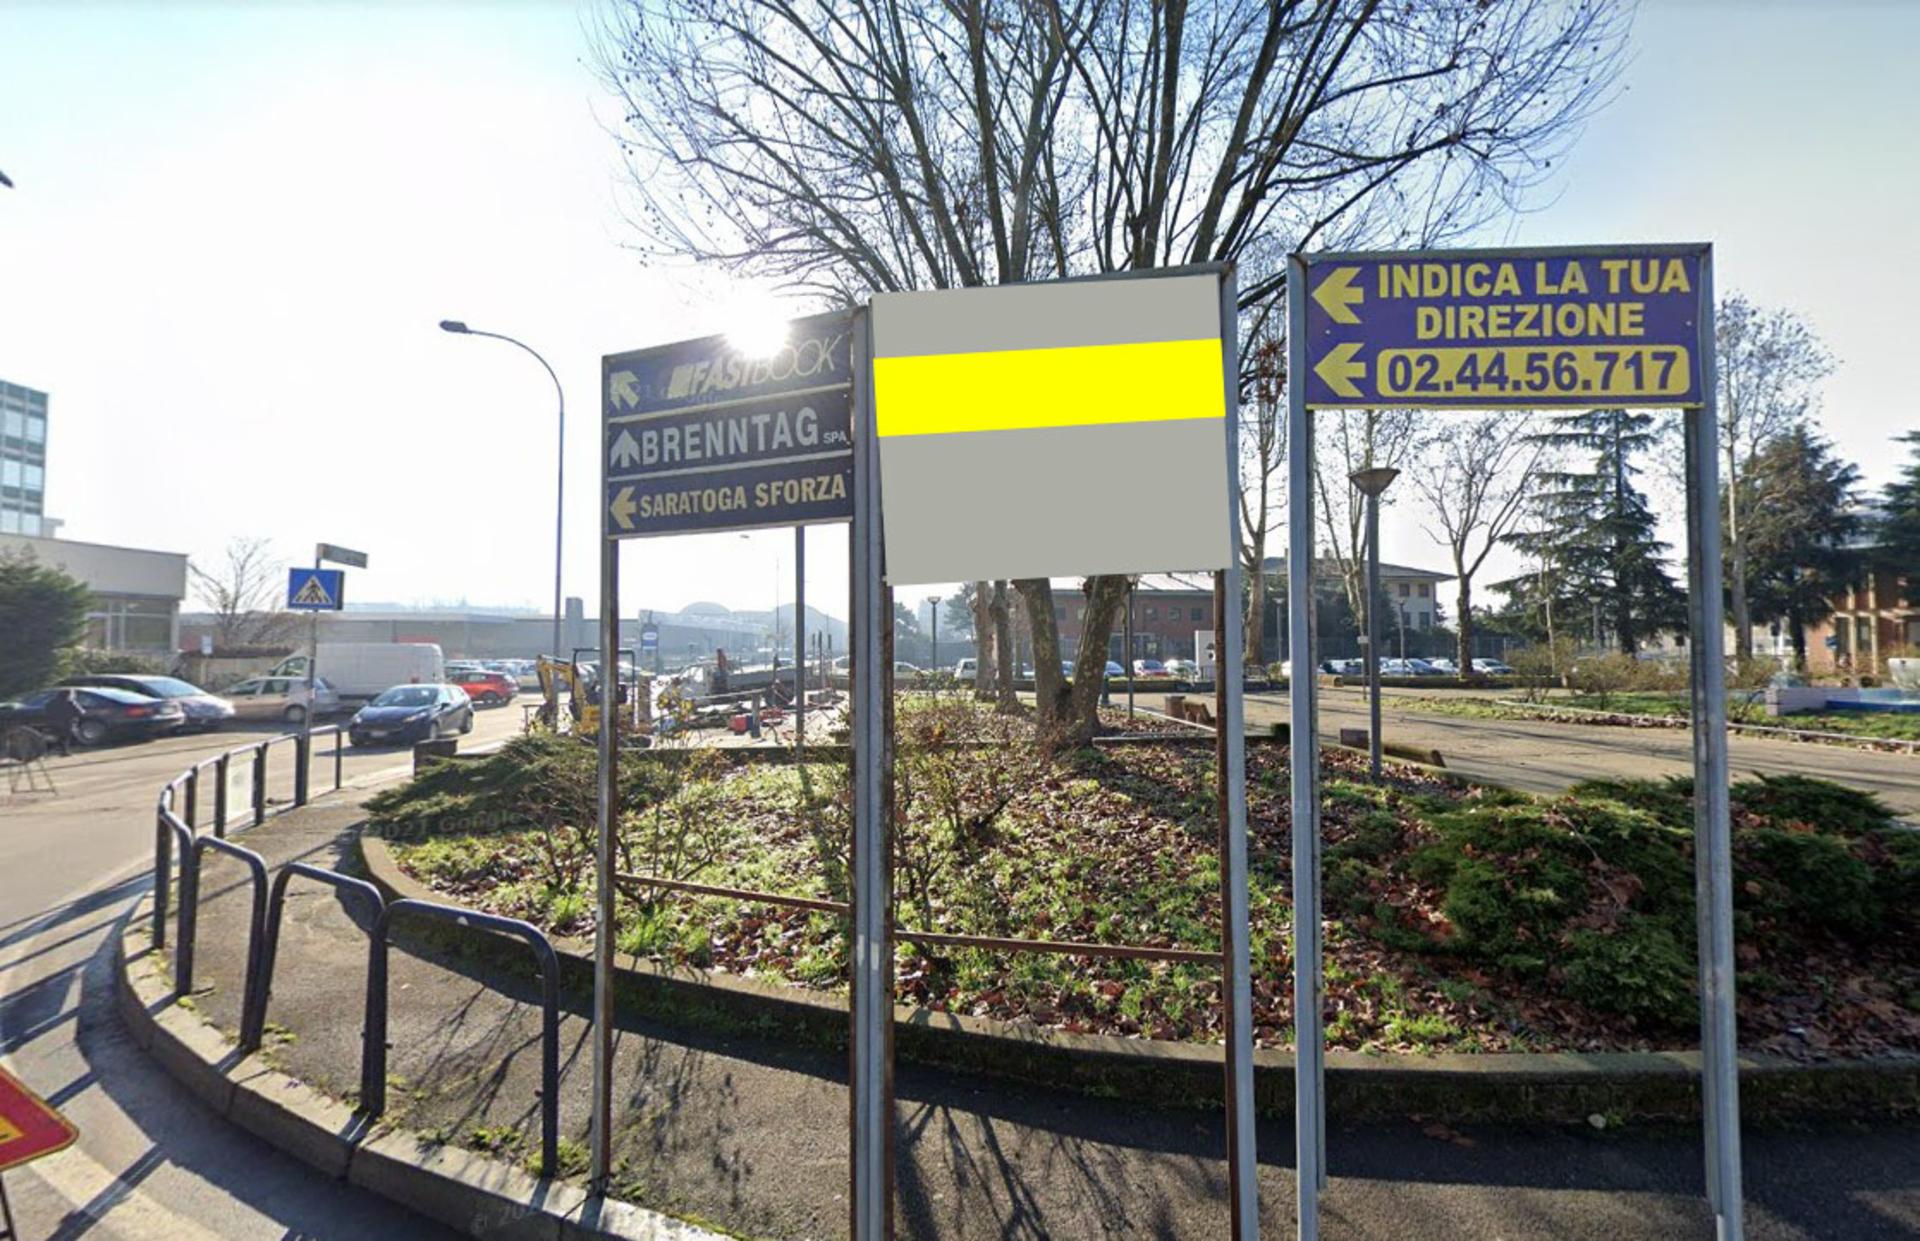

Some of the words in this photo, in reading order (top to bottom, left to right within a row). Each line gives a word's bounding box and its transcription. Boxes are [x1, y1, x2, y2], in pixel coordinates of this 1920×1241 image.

[1377, 263, 1522, 299] INDICA
[1535, 261, 1589, 295] LA
[1602, 258, 1691, 294] TUA
[1416, 303, 1645, 340] DIREZIONE
[1387, 351, 1678, 392] 02.44.56.717
[642, 407, 818, 465] BRENNTAG
[823, 431, 847, 444] SPA
[640, 486, 747, 518] SARATOGA
[755, 474, 846, 507] SFORZA
